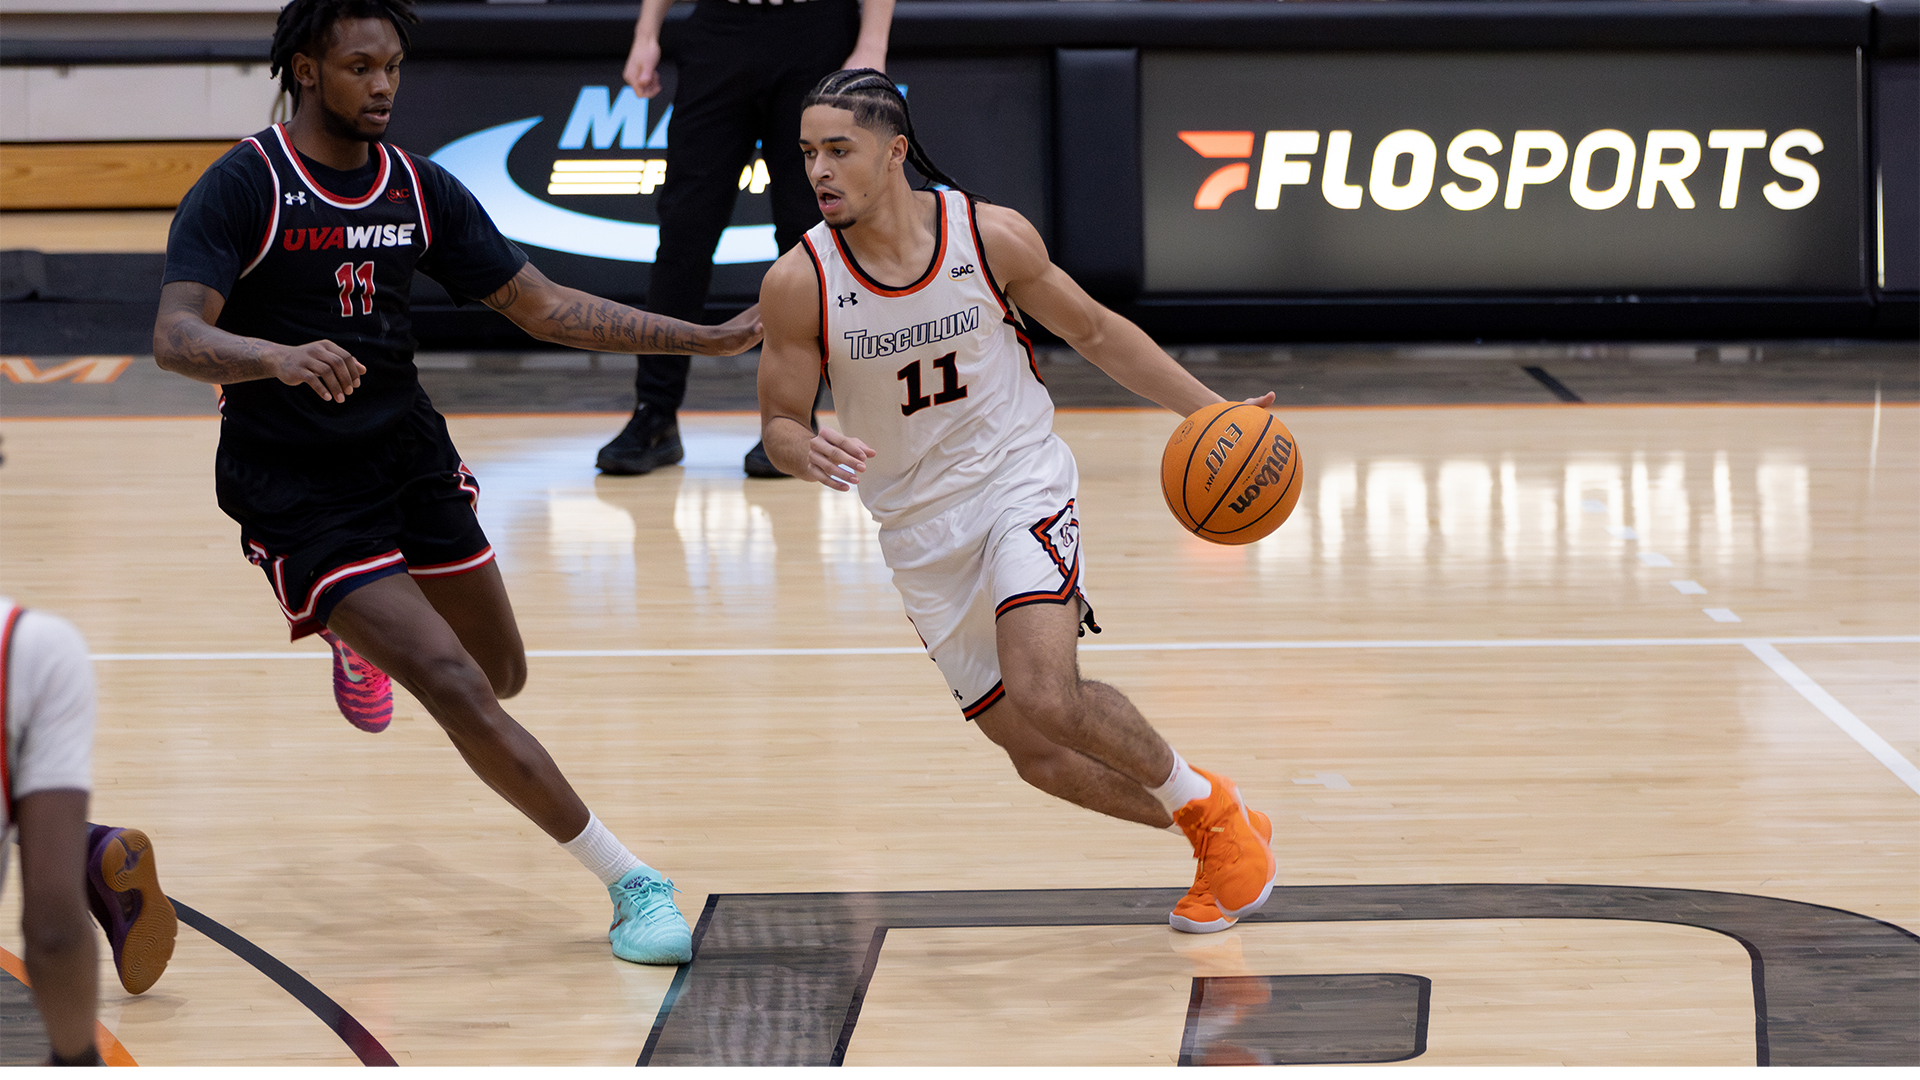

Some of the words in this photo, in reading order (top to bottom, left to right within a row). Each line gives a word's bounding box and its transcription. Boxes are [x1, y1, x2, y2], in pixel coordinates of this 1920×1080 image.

[389, 188, 410, 199] SAC
[1254, 129, 1825, 211] FLOSPORTS
[335, 261, 376, 318] 11
[950, 264, 975, 279] SAC
[844, 305, 979, 360] TUSCULUM
[897, 351, 968, 417] 11
[1204, 422, 1243, 476] EVO
[1228, 434, 1293, 514] Wilson
